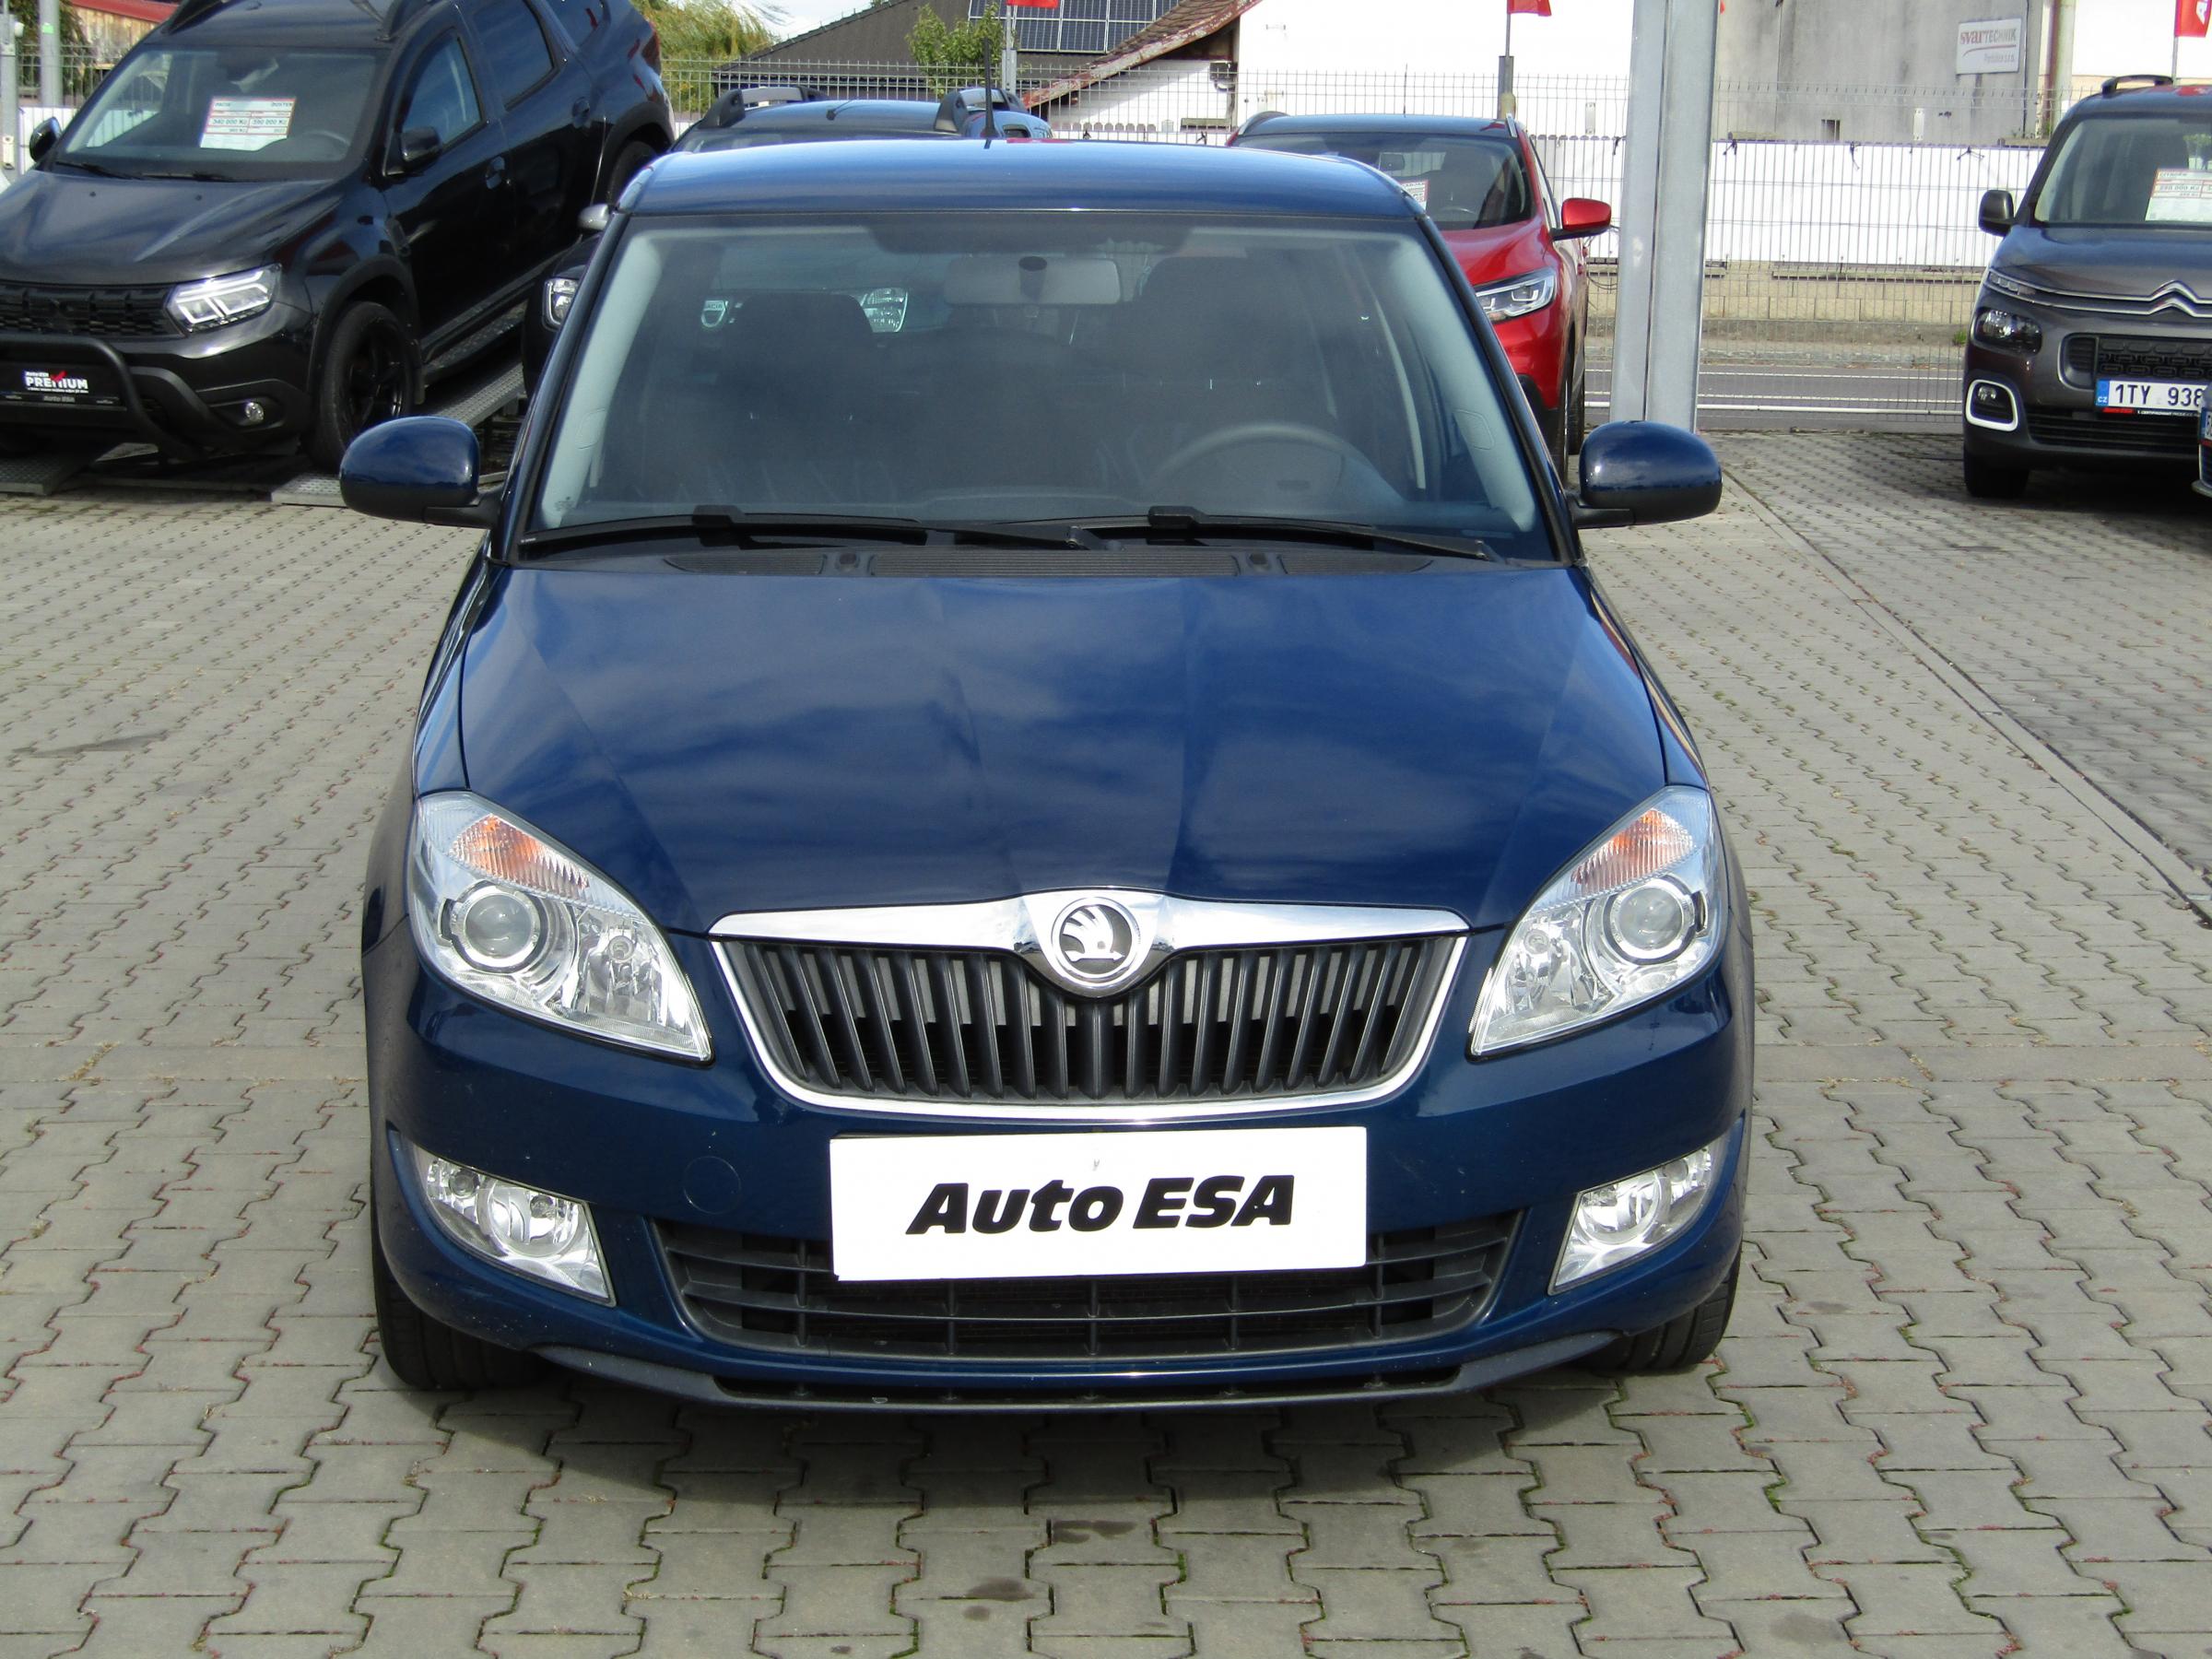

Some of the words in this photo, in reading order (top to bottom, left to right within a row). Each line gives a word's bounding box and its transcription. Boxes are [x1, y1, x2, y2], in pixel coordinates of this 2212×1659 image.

[2115, 383, 2151, 406] 1TY
[905, 1179, 1124, 1235] Auto
[1132, 1174, 1295, 1230] ESA
